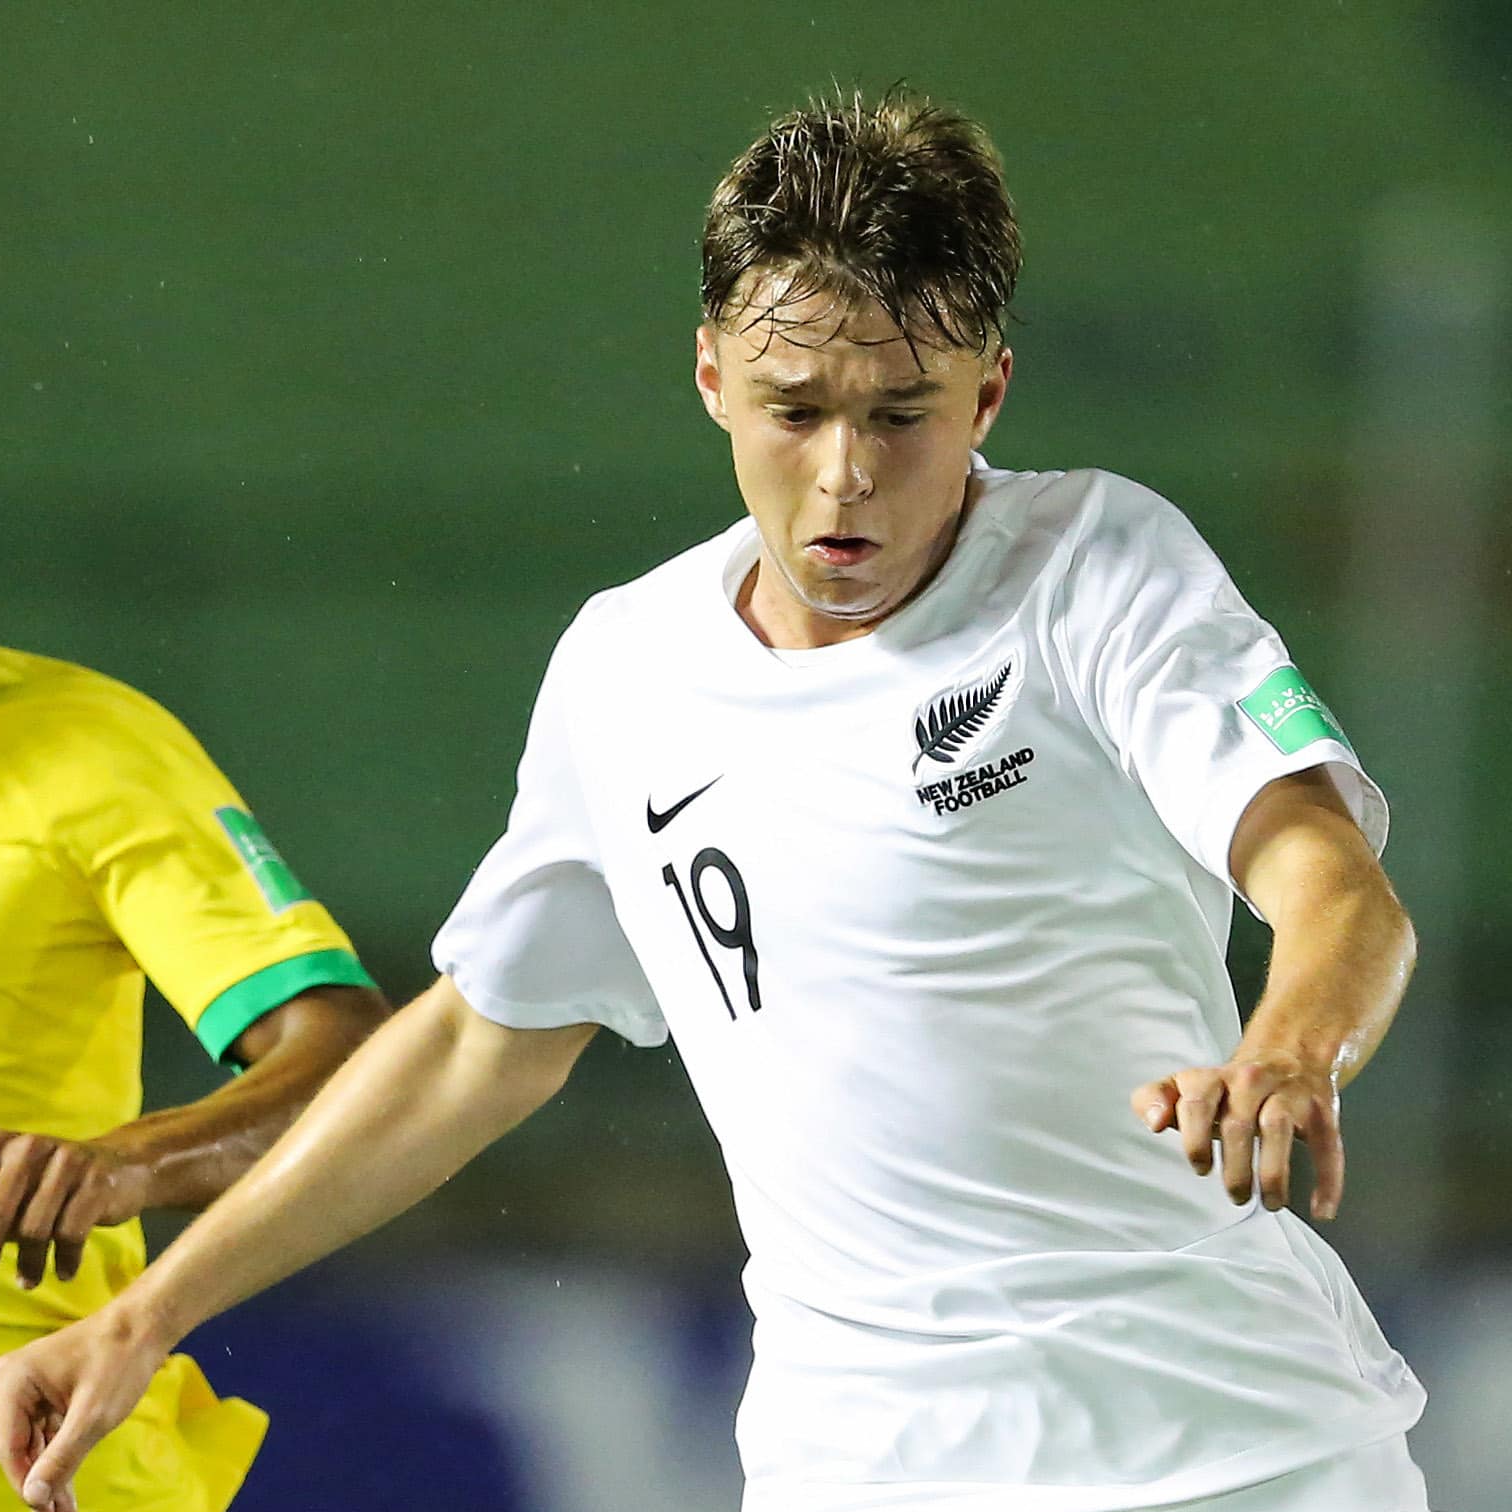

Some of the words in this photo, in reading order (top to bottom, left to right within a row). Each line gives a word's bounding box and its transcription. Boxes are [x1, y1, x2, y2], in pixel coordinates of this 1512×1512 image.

[916, 779, 953, 804] NEW
[954, 748, 1034, 791] ZEALAND
[934, 769, 1028, 816] FOOTBALL
[661, 847, 761, 1021] 19
